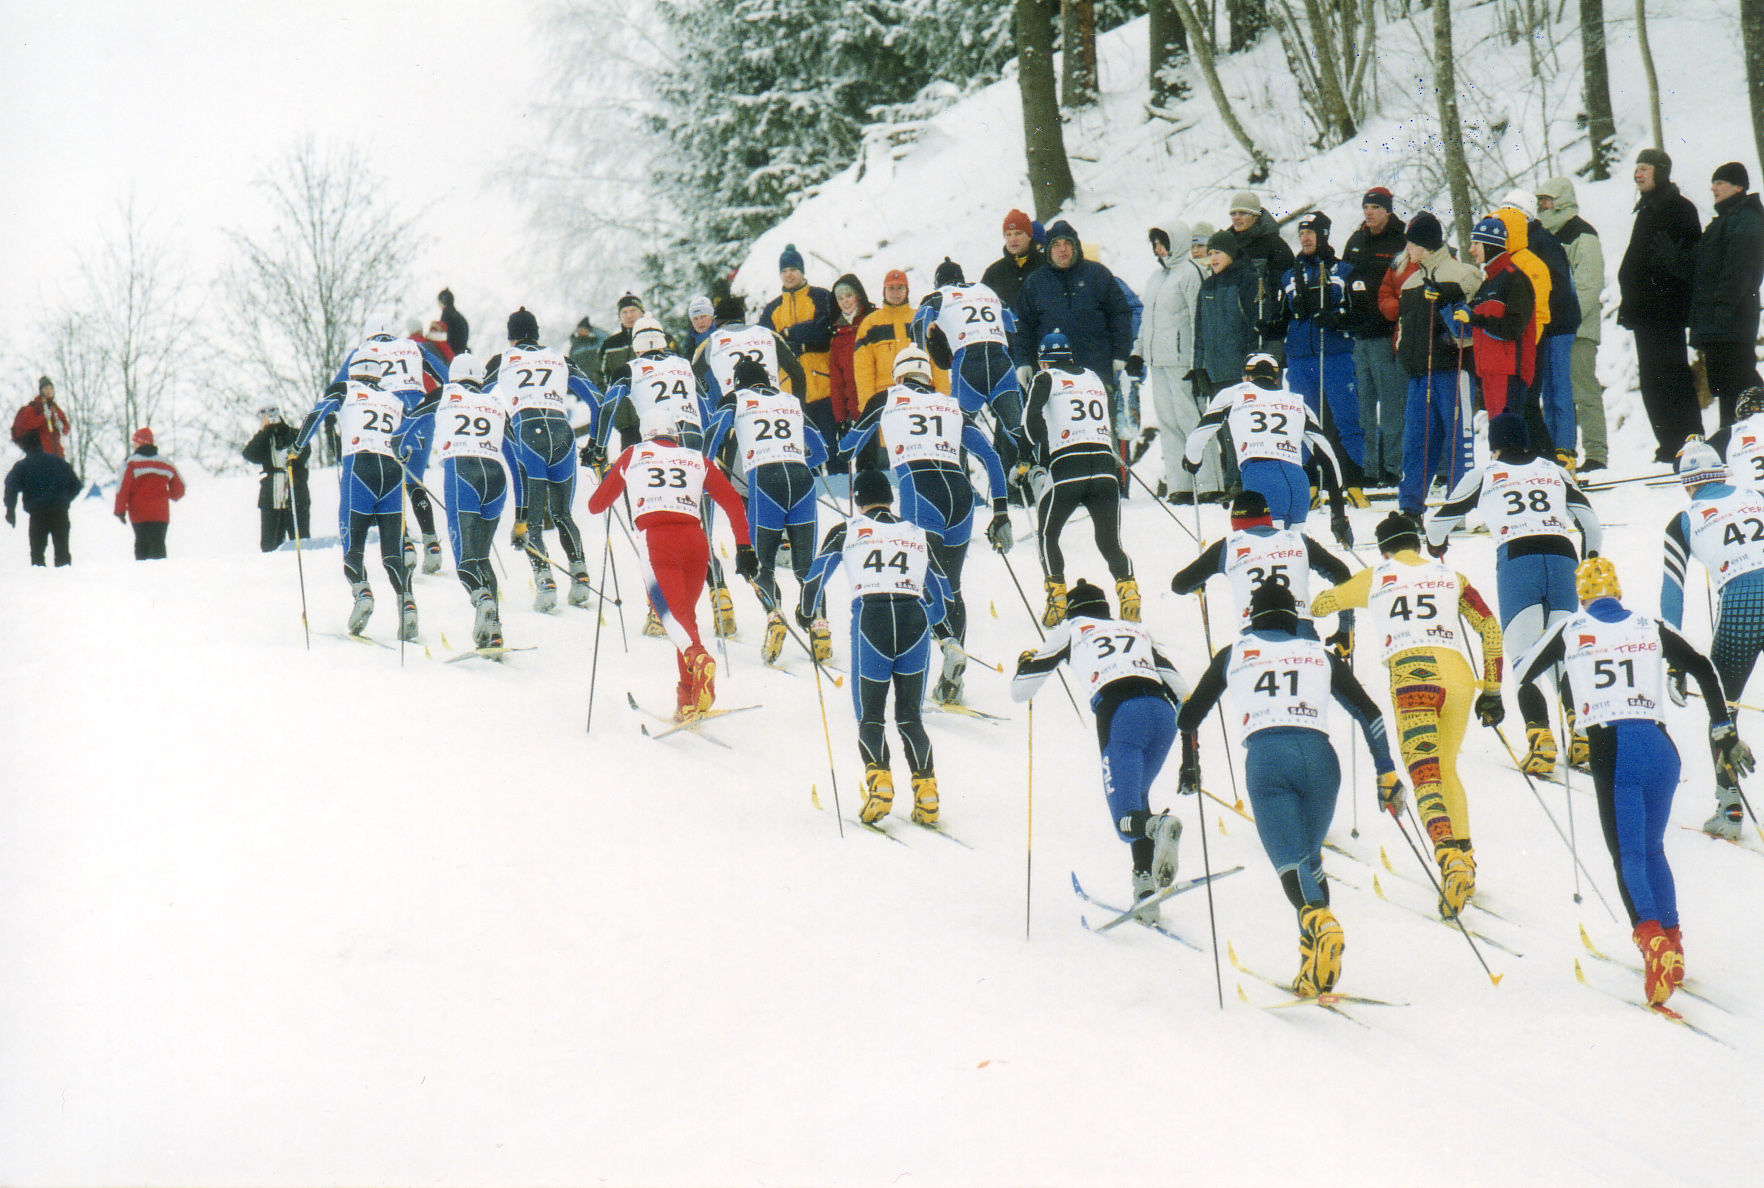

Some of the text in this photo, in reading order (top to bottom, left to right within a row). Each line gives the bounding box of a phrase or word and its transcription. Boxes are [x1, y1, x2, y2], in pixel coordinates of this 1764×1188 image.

[961, 306, 996, 324] 26
[379, 359, 408, 377] 21
[516, 368, 553, 388] 27
[650, 380, 688, 403] 24
[925, 404, 960, 416] TERE
[1070, 399, 1104, 421] 30
[1271, 403, 1302, 414] TERE
[362, 409, 394, 434] 25
[454, 414, 491, 437] 29
[753, 418, 792, 442] 28
[908, 414, 943, 437] 31
[1250, 411, 1288, 435] 32
[668, 458, 701, 470] TERE
[647, 467, 687, 488] 33
[1525, 477, 1561, 487] TERE
[1503, 489, 1551, 516] 38
[1723, 517, 1764, 546] 42
[888, 538, 924, 553] TERE
[1267, 549, 1303, 560] TERE
[863, 549, 910, 575] 44
[1414, 580, 1455, 590] TERE
[1389, 594, 1438, 621] 45
[1092, 635, 1136, 659] 37
[1614, 642, 1657, 654] TERE
[1279, 656, 1324, 667] TERE
[1254, 670, 1299, 697] 41
[1594, 659, 1635, 689] 51
